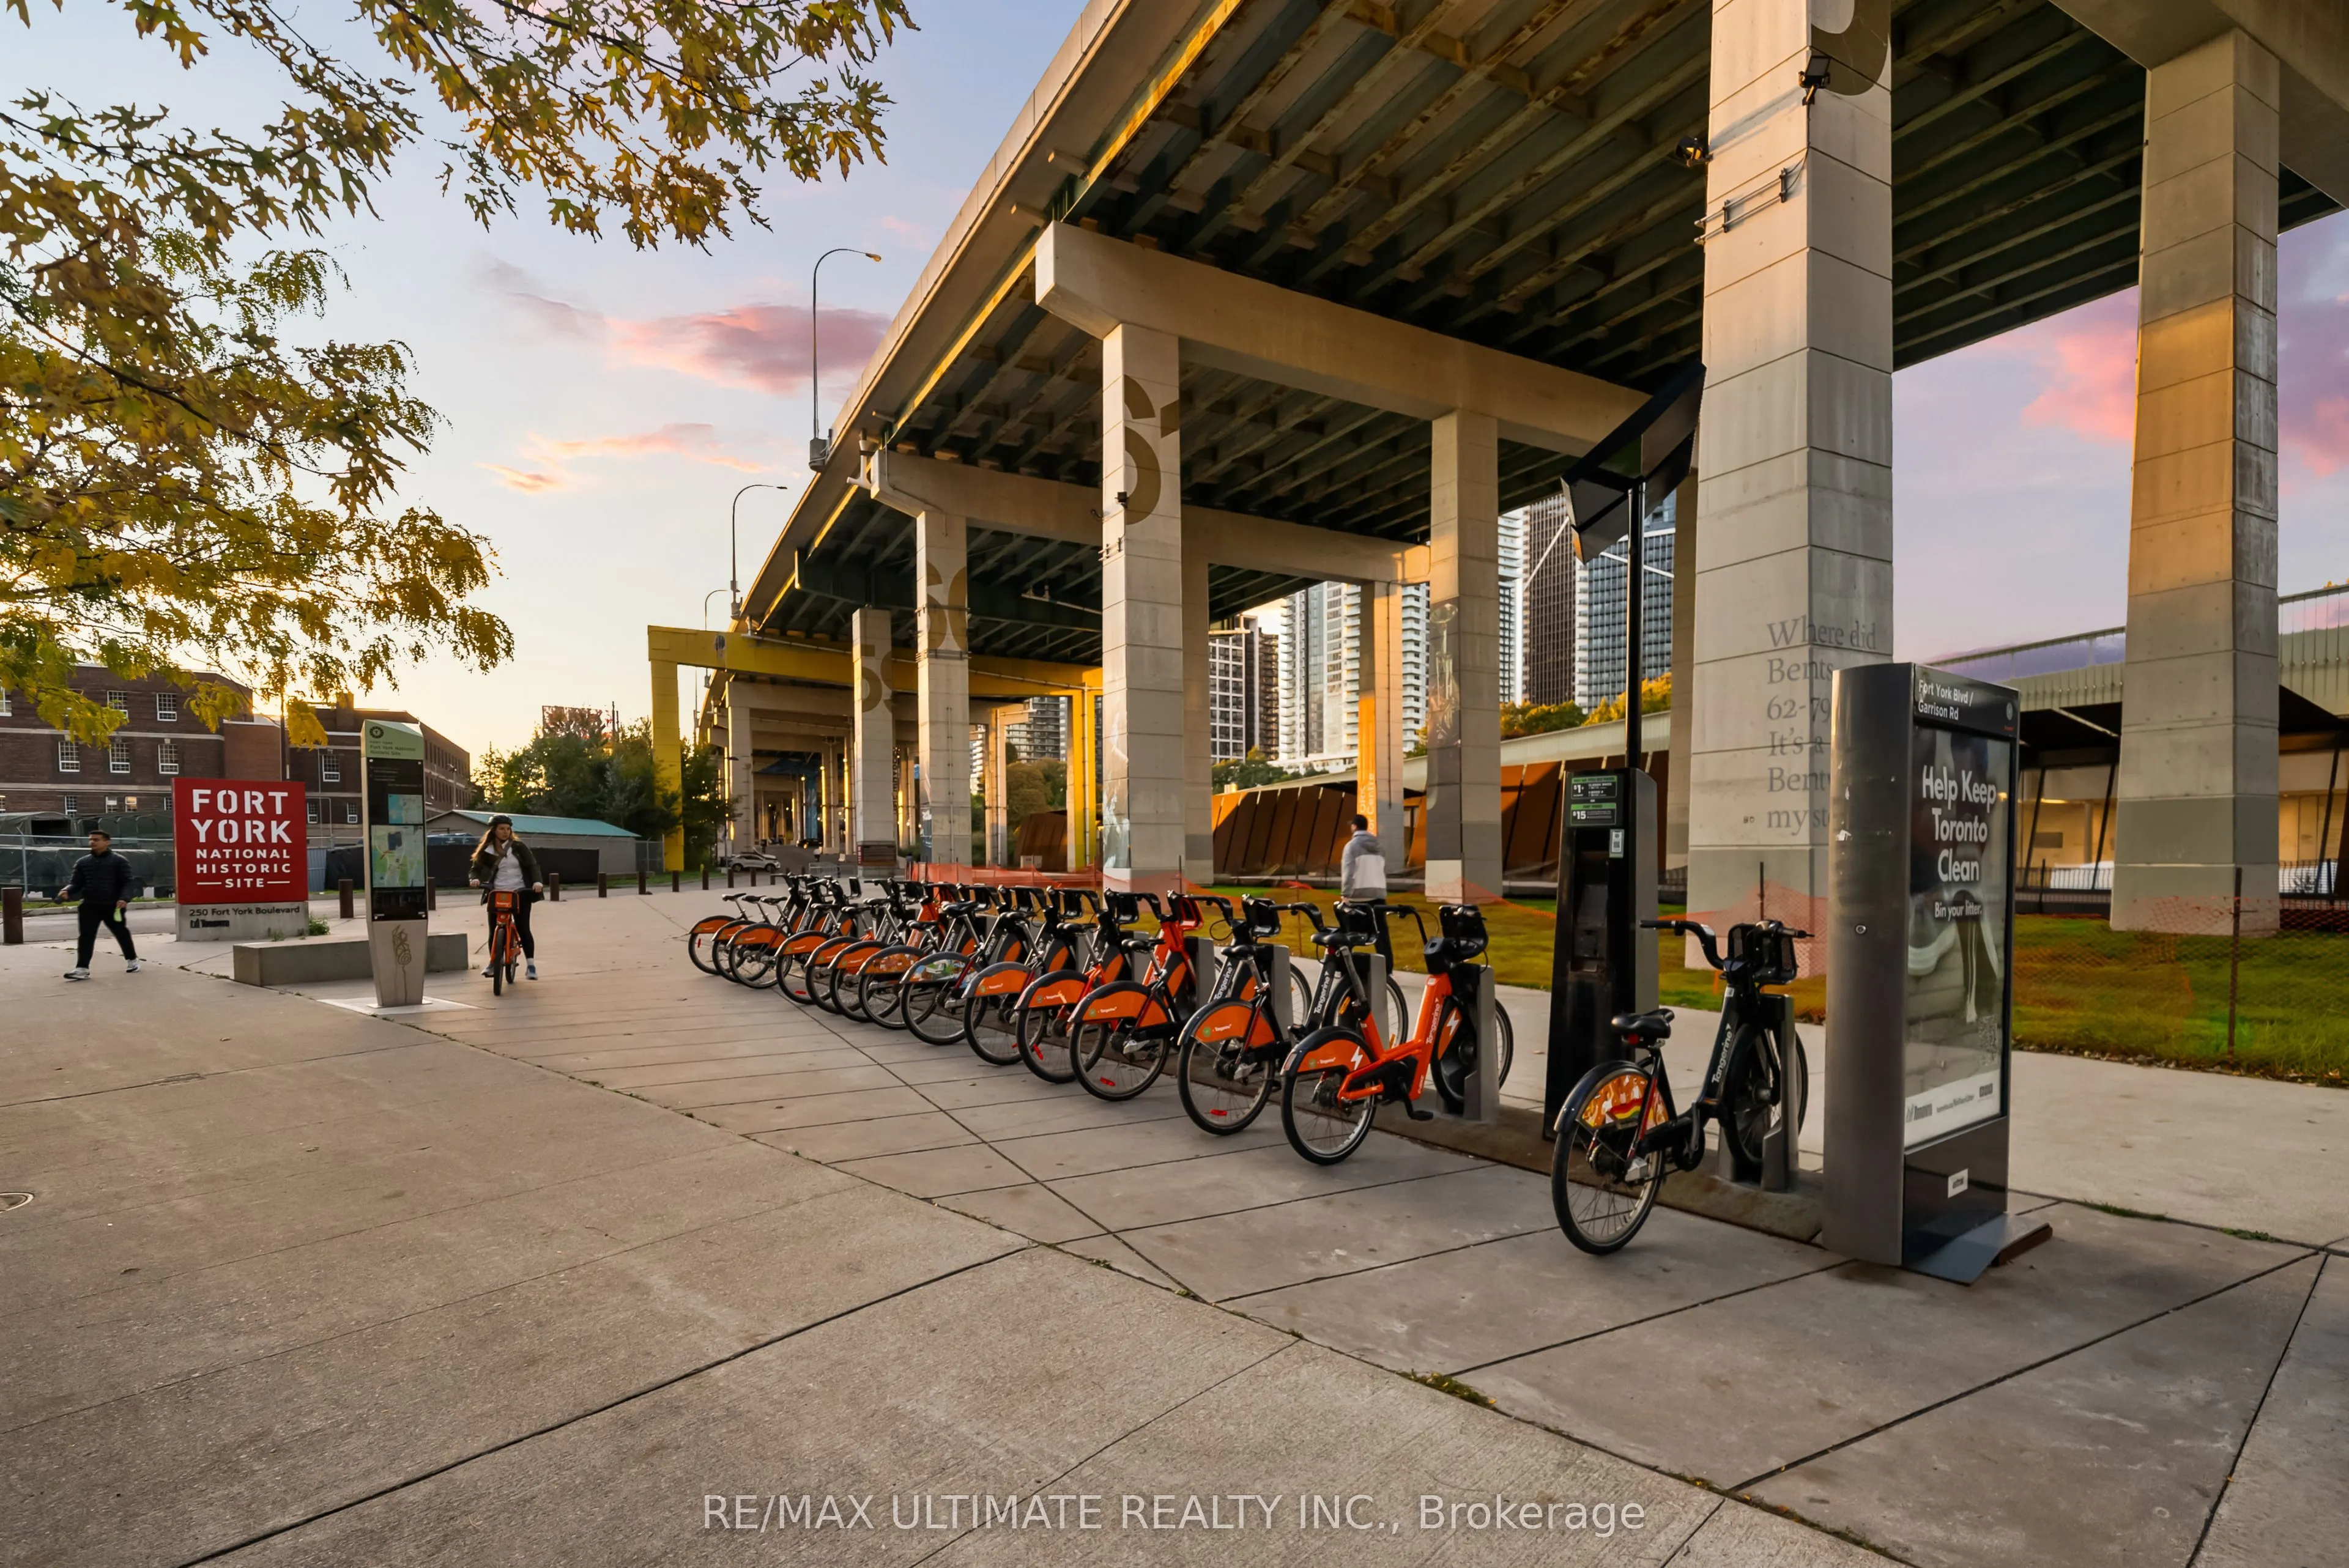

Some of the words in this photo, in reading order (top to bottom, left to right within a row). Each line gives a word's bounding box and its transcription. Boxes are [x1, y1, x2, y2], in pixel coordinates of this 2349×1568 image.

[1767, 614, 1844, 648] Where
[1850, 620, 1877, 649] did
[1767, 657, 1834, 685] Bents
[1918, 679, 1934, 696] Fort
[1935, 684, 1951, 700] York
[1953, 688, 1969, 704] Blvd
[1918, 700, 1948, 719] Garrison
[1949, 706, 1959, 720] Rd
[1769, 727, 1804, 757] It's
[192, 788, 289, 815] FORT
[1922, 764, 1958, 810] Help
[1961, 769, 1997, 813] Keep
[190, 818, 292, 843] YORK
[1931, 807, 1988, 842] Toronto
[196, 849, 291, 859] NATIONAL
[196, 863, 291, 873] HISTORIC
[1937, 848, 1980, 882] Clean
[225, 878, 264, 887] SITE
[232, 906, 253, 915] York
[256, 906, 300, 914] Boulevard
[1934, 901, 1946, 918] Bin
[1948, 904, 1964, 922] your
[1965, 900, 1983, 915] litter.
[1213, 966, 1233, 1000] Tangerine
[1313, 977, 1330, 1015] Tangerine
[1425, 1003, 1441, 1045] Tangerine
[1711, 1032, 1732, 1084] Tangerine
